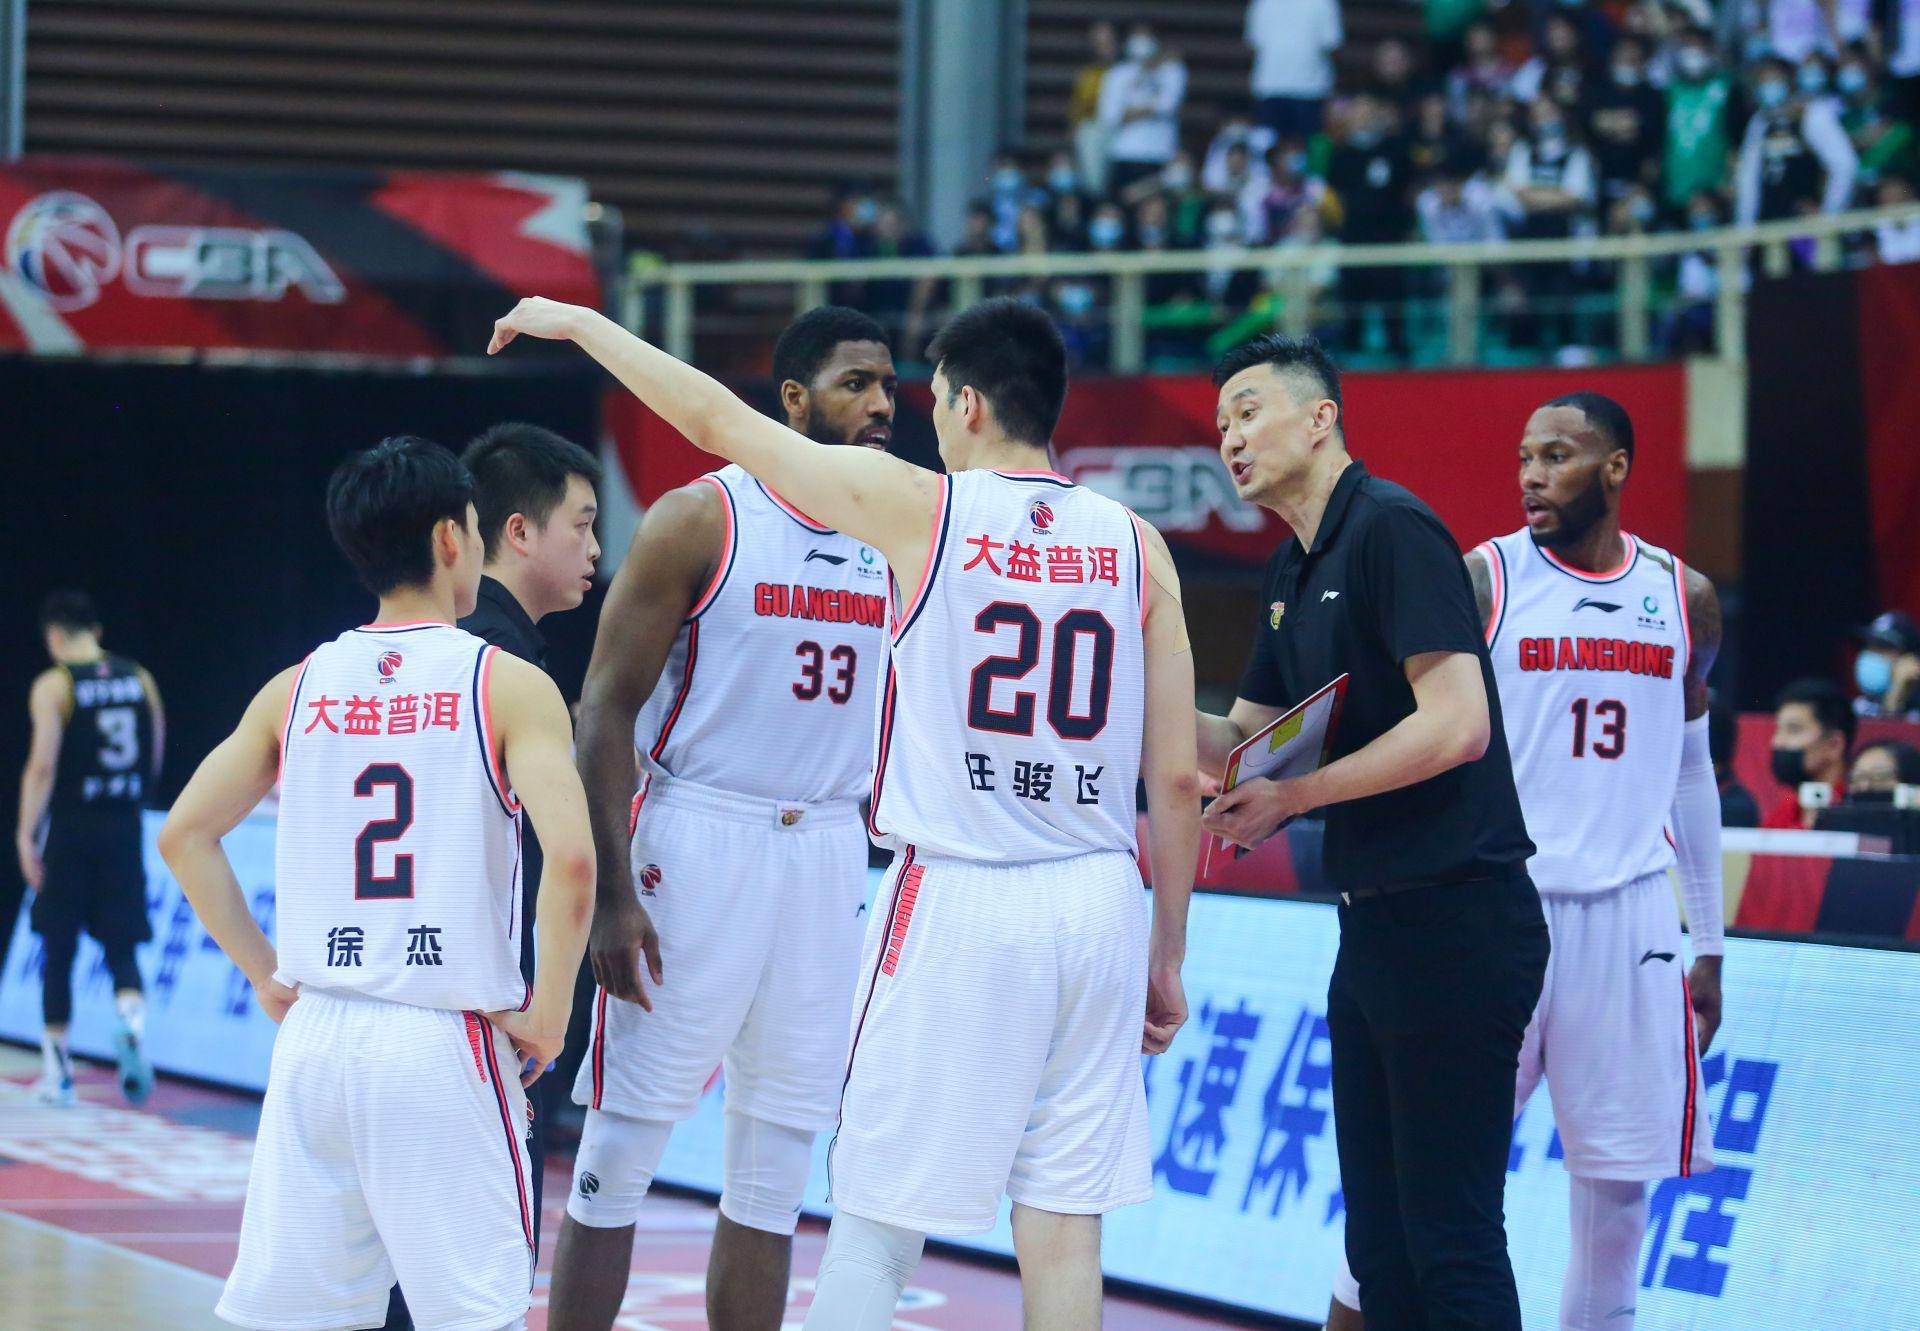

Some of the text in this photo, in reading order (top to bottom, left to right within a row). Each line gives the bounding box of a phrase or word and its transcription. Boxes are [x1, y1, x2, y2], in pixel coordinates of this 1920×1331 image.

[123, 224, 348, 304] CBA
[963, 534, 1120, 587] 大益普洱
[754, 582, 886, 629] GUANGDON
[792, 640, 858, 705] 33
[967, 600, 1116, 741] 20
[1518, 636, 1675, 679] GUANGDONG
[97, 706, 139, 770] 3
[304, 692, 462, 735] 大益普洱
[1571, 698, 1627, 760] 13
[354, 762, 415, 900] 2
[881, 863, 926, 977] GUANGDONG
